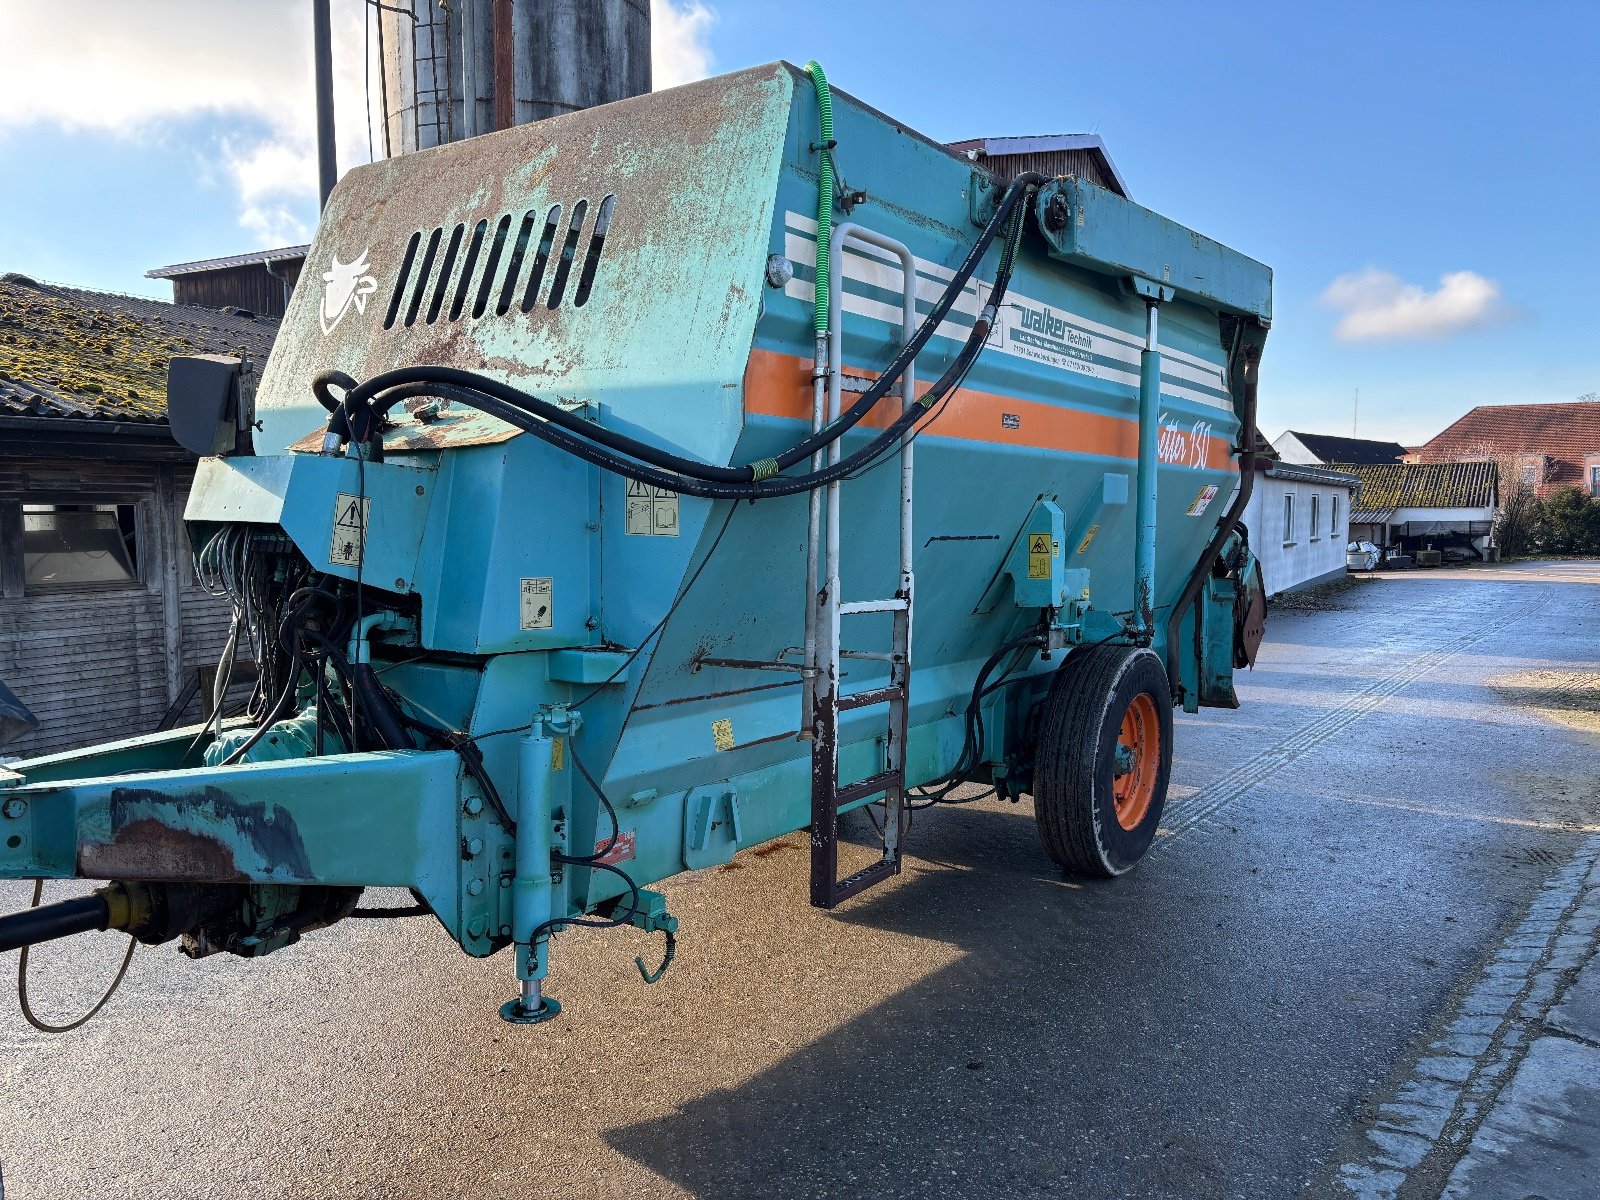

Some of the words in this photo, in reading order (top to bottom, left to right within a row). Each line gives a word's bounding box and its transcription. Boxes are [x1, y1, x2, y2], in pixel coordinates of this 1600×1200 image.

[1021, 307, 1066, 340] walker
[1067, 329, 1093, 349] Technik
[1158, 412, 1187, 463] etter
[1189, 420, 1212, 470] 130
